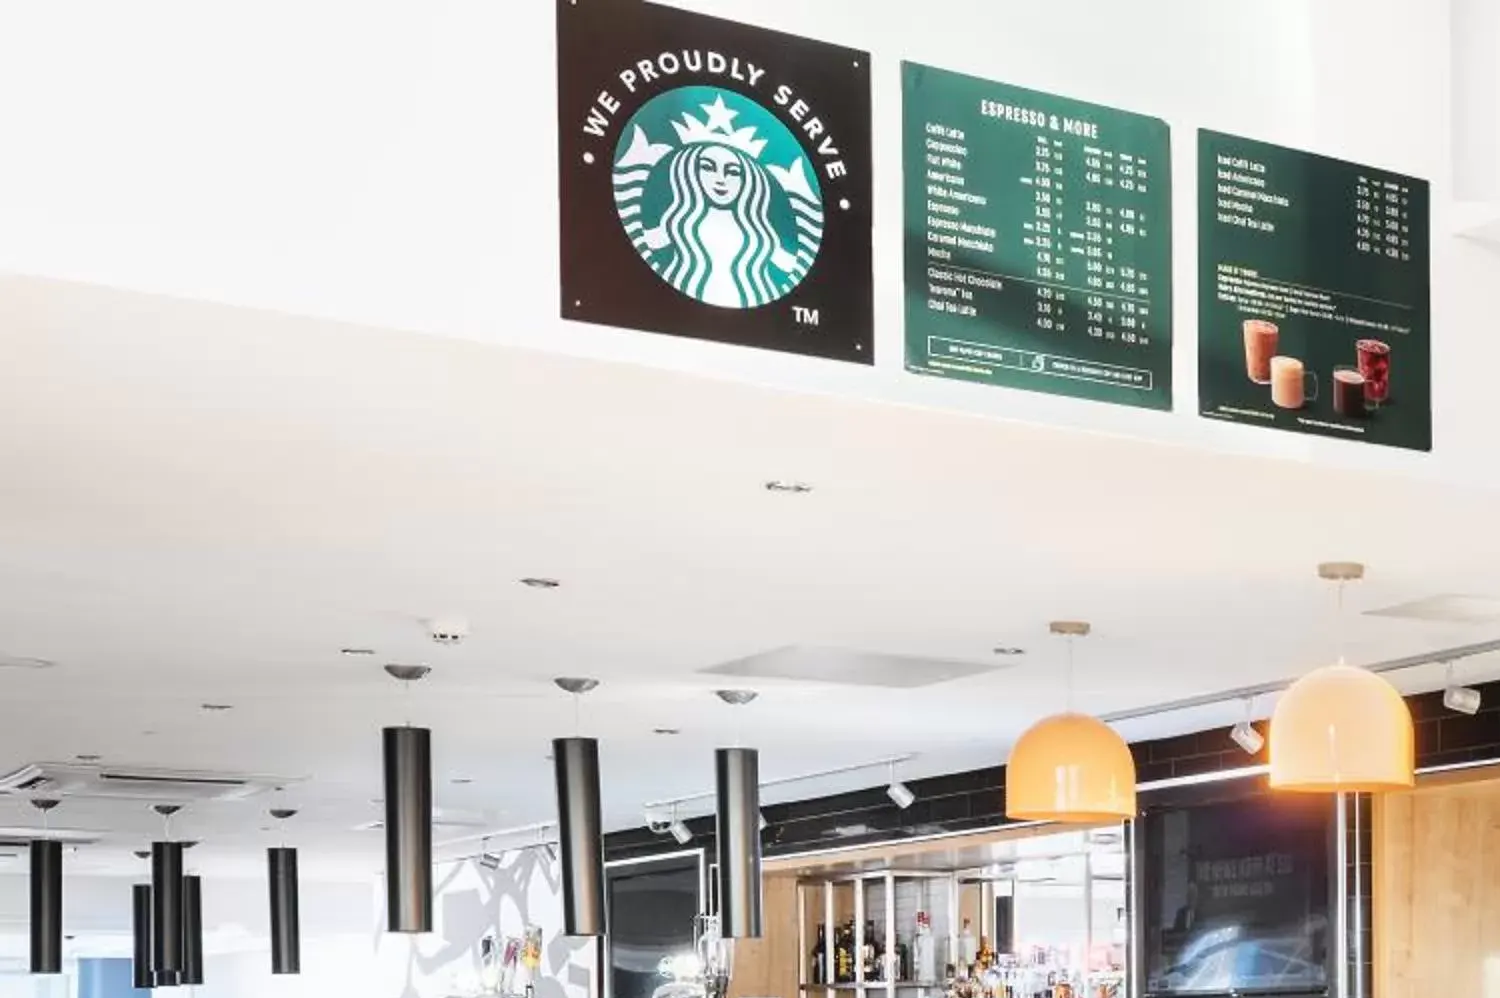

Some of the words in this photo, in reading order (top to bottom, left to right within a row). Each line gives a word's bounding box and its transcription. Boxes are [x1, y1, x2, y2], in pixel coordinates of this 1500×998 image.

[583, 90, 621, 137] WE
[619, 50, 765, 92] PROUDLY
[773, 84, 847, 179] SERVE
[981, 99, 1045, 127] ESPRESSO
[1049, 114, 1059, 131] &
[1063, 118, 1098, 139] MORE
[792, 306, 820, 327] TM
